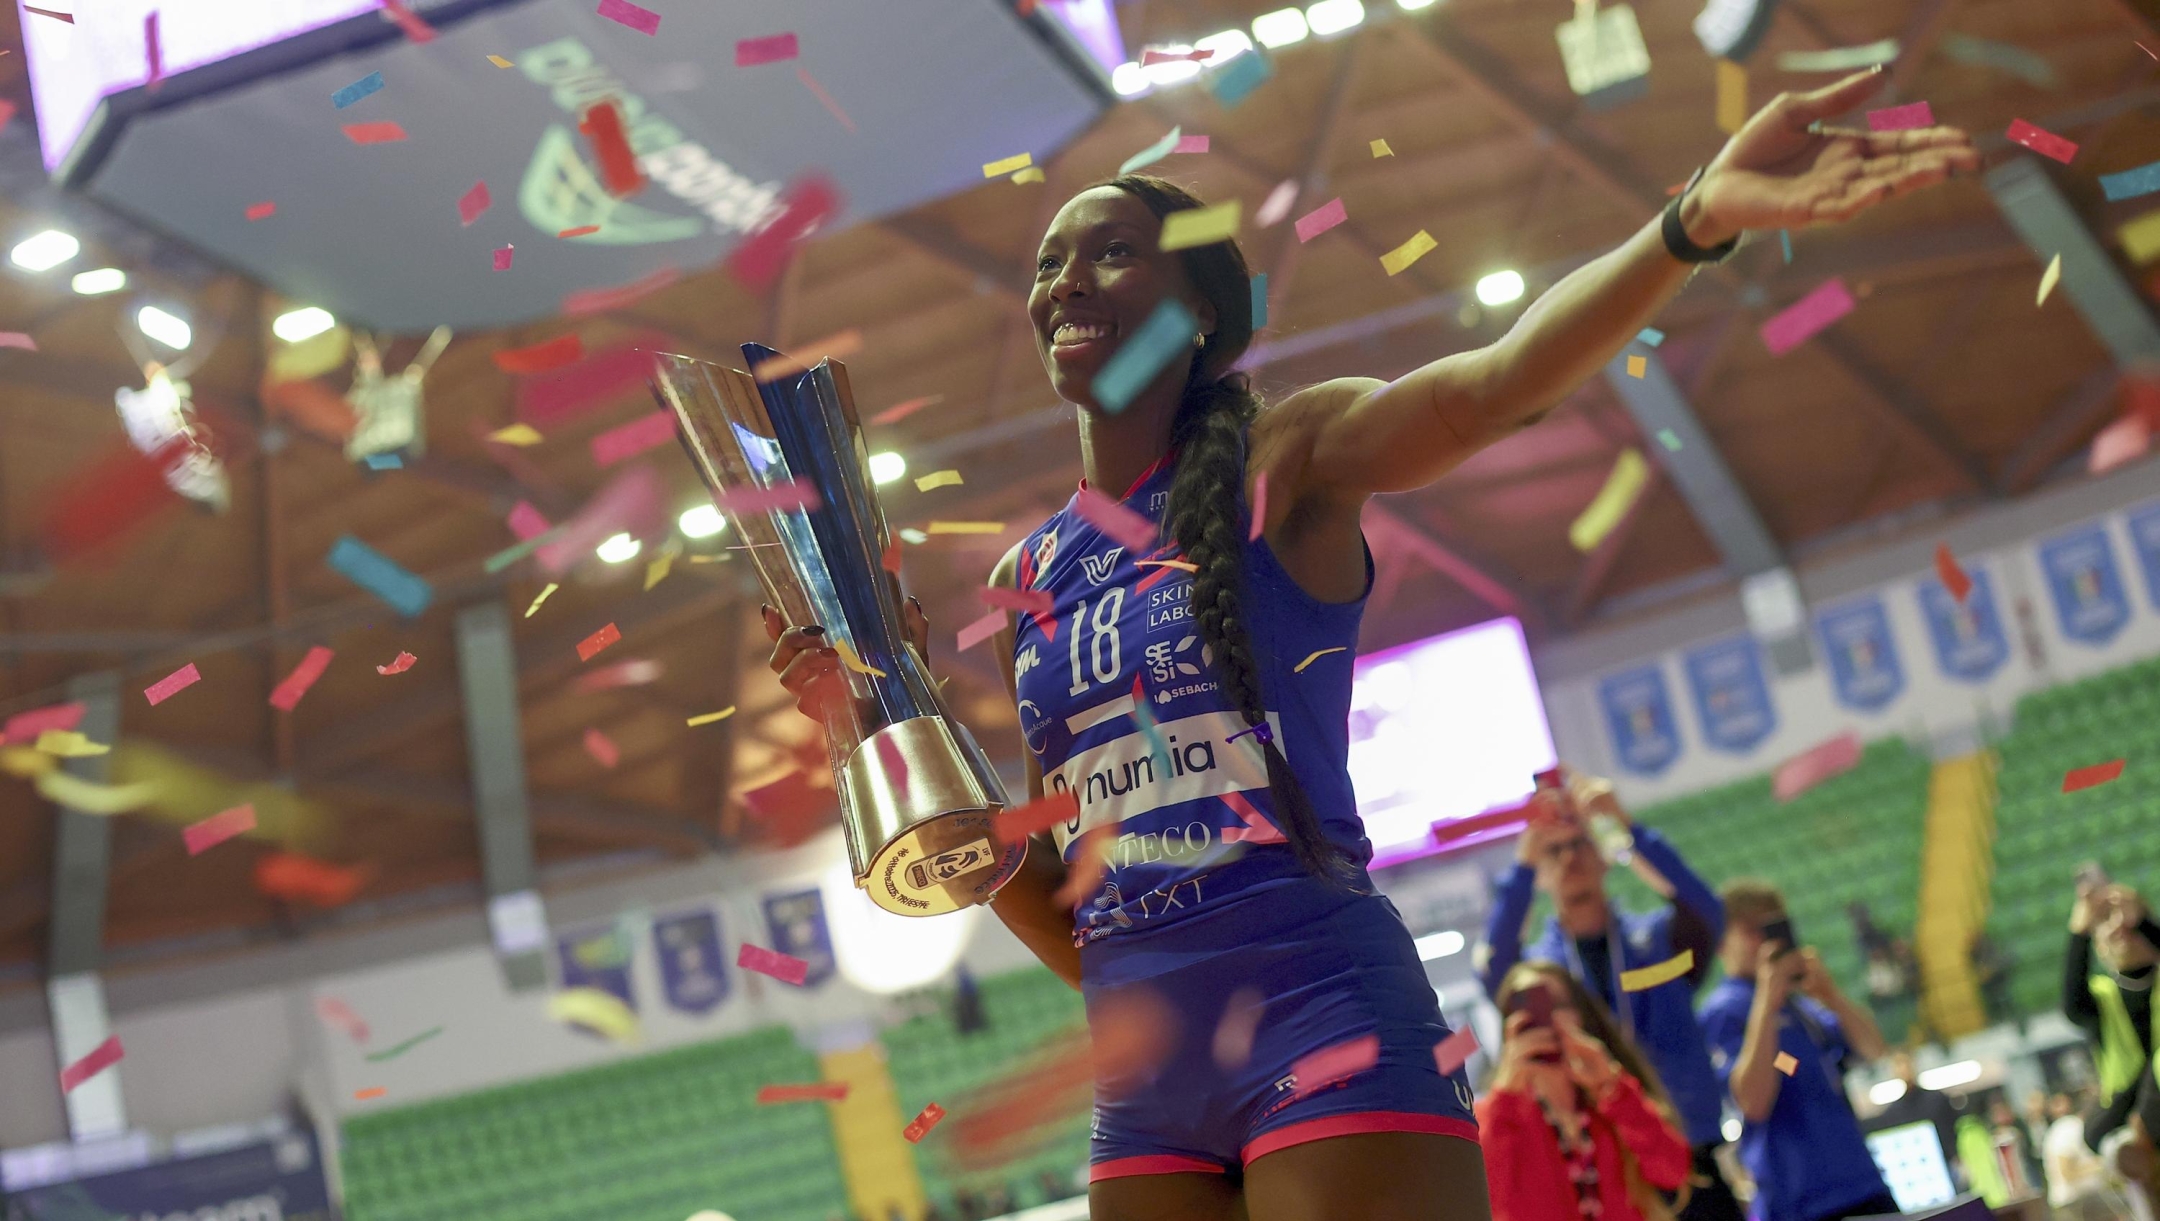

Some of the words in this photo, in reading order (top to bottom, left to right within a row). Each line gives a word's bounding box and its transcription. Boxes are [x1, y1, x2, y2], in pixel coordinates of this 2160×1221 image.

[1069, 586, 1125, 697] 18
[1171, 682, 1219, 698] SEBACH
[1087, 735, 1216, 805] numia
[1096, 821, 1211, 879] NTECO
